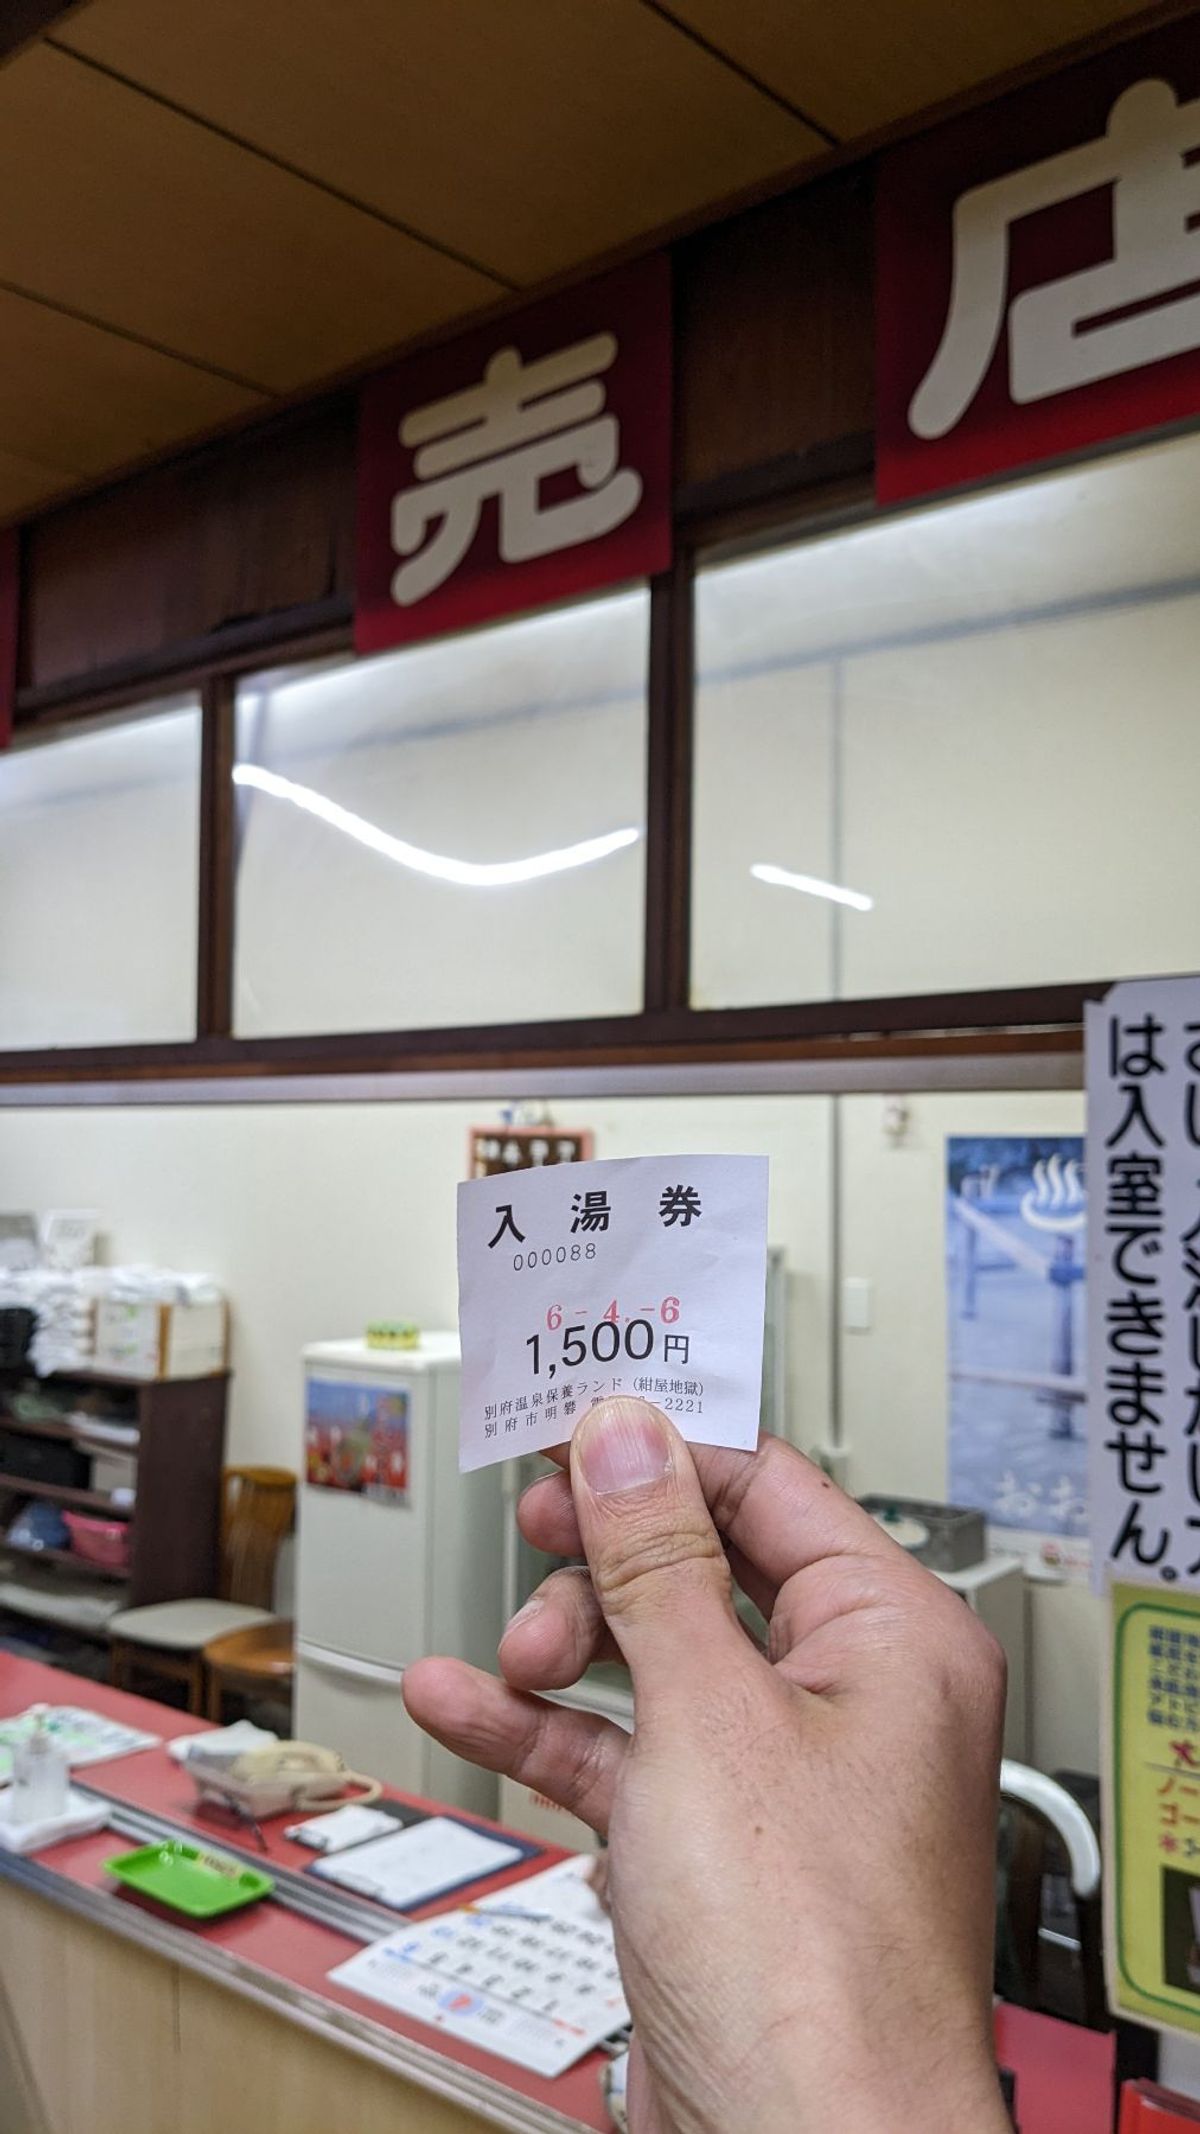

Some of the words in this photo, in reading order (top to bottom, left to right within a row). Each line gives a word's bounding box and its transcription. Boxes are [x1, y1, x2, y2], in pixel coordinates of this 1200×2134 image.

[513, 1243, 597, 1271] 000088
[1105, 1012, 1178, 1582] は入室できません。
